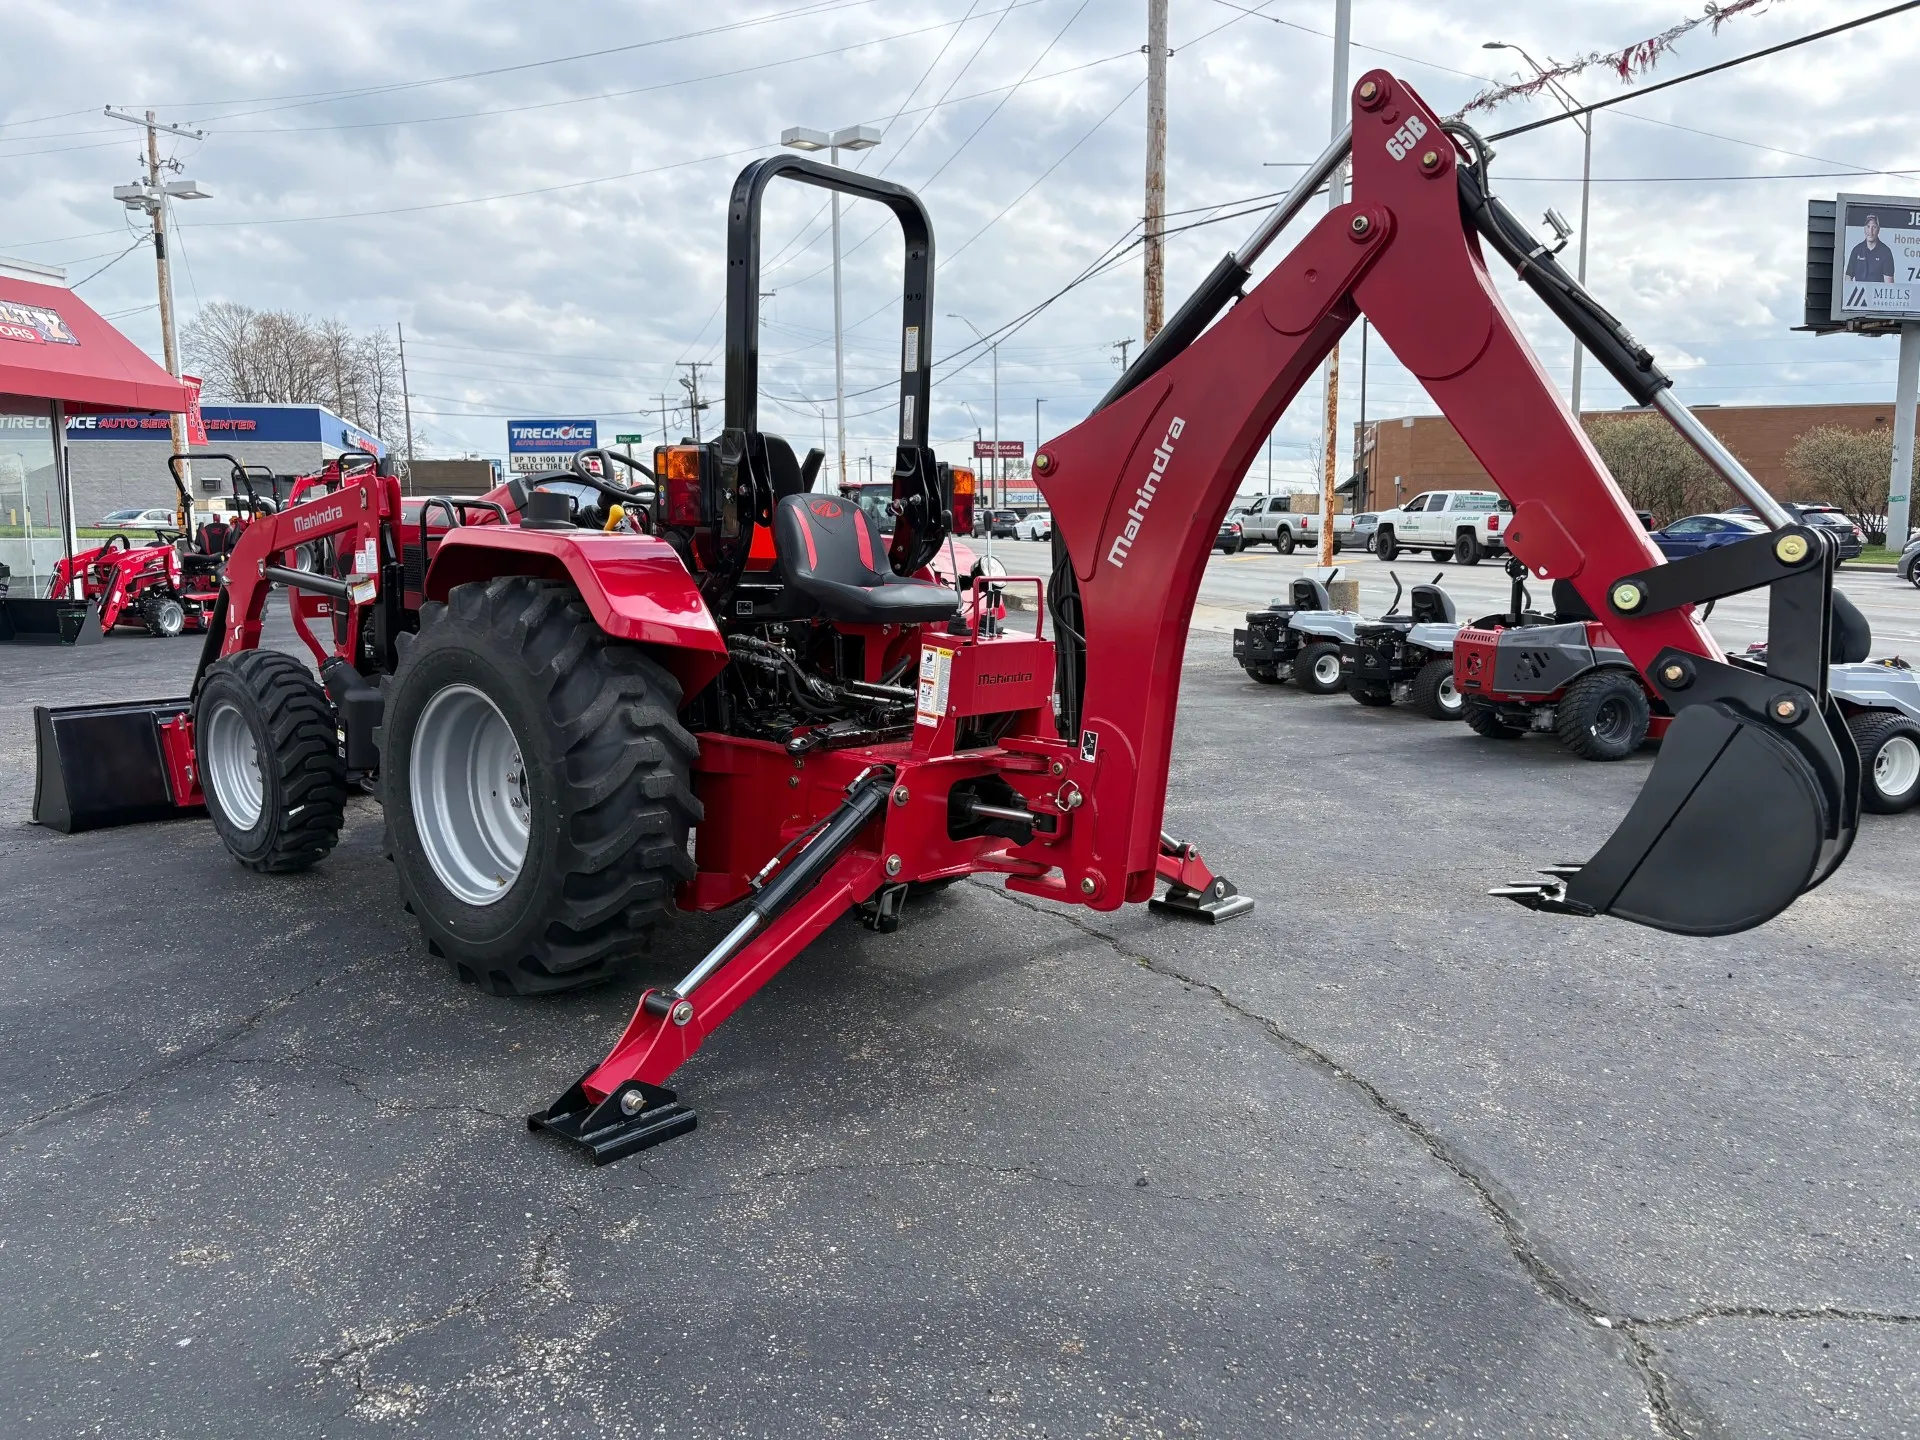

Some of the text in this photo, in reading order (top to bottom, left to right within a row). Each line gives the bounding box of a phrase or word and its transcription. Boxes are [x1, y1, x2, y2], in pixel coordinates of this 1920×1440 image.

[1385, 115, 1428, 161] 65B
[1873, 288, 1910, 300] MILLS
[99, 418, 139, 429] AUTO
[204, 420, 257, 430] CENTER
[1005, 493, 1035, 502] Original
[1107, 415, 1186, 568] Mahindra
[293, 505, 343, 532] Mahindra
[978, 672, 1033, 686] Mahindra
